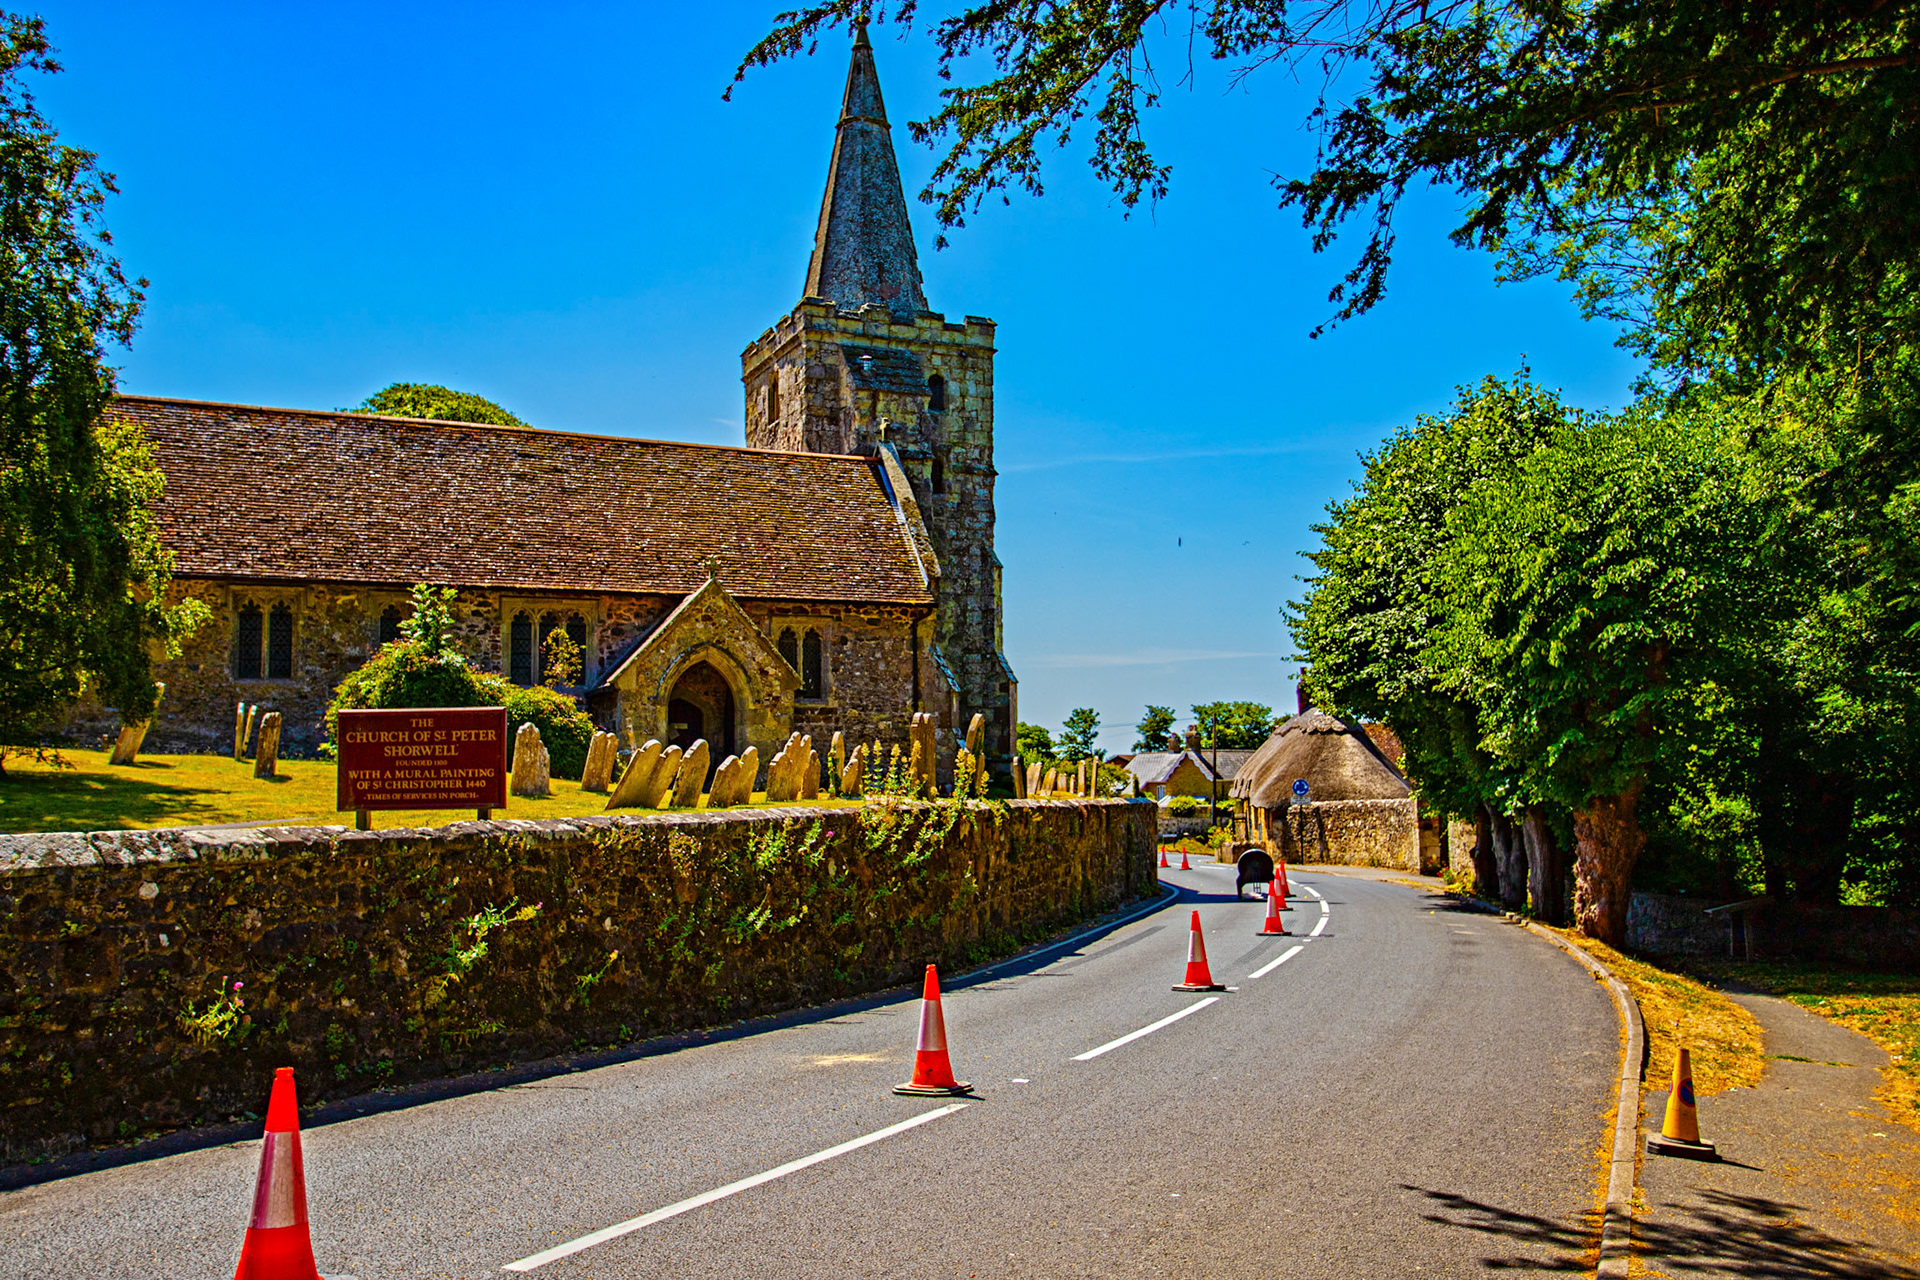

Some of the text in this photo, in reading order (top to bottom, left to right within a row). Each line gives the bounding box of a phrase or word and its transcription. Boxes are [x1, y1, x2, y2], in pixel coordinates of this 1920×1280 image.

[410, 718, 434, 728] THE
[346, 731, 409, 743] CHURCH
[414, 731, 431, 742] OF
[452, 730, 497, 741] PETER
[384, 745, 459, 757] SHORWELL
[349, 768, 495, 780] WITH A MURAL PAINTING
[357, 781, 370, 790] OF
[385, 780, 463, 789] CHRISTOPHER
